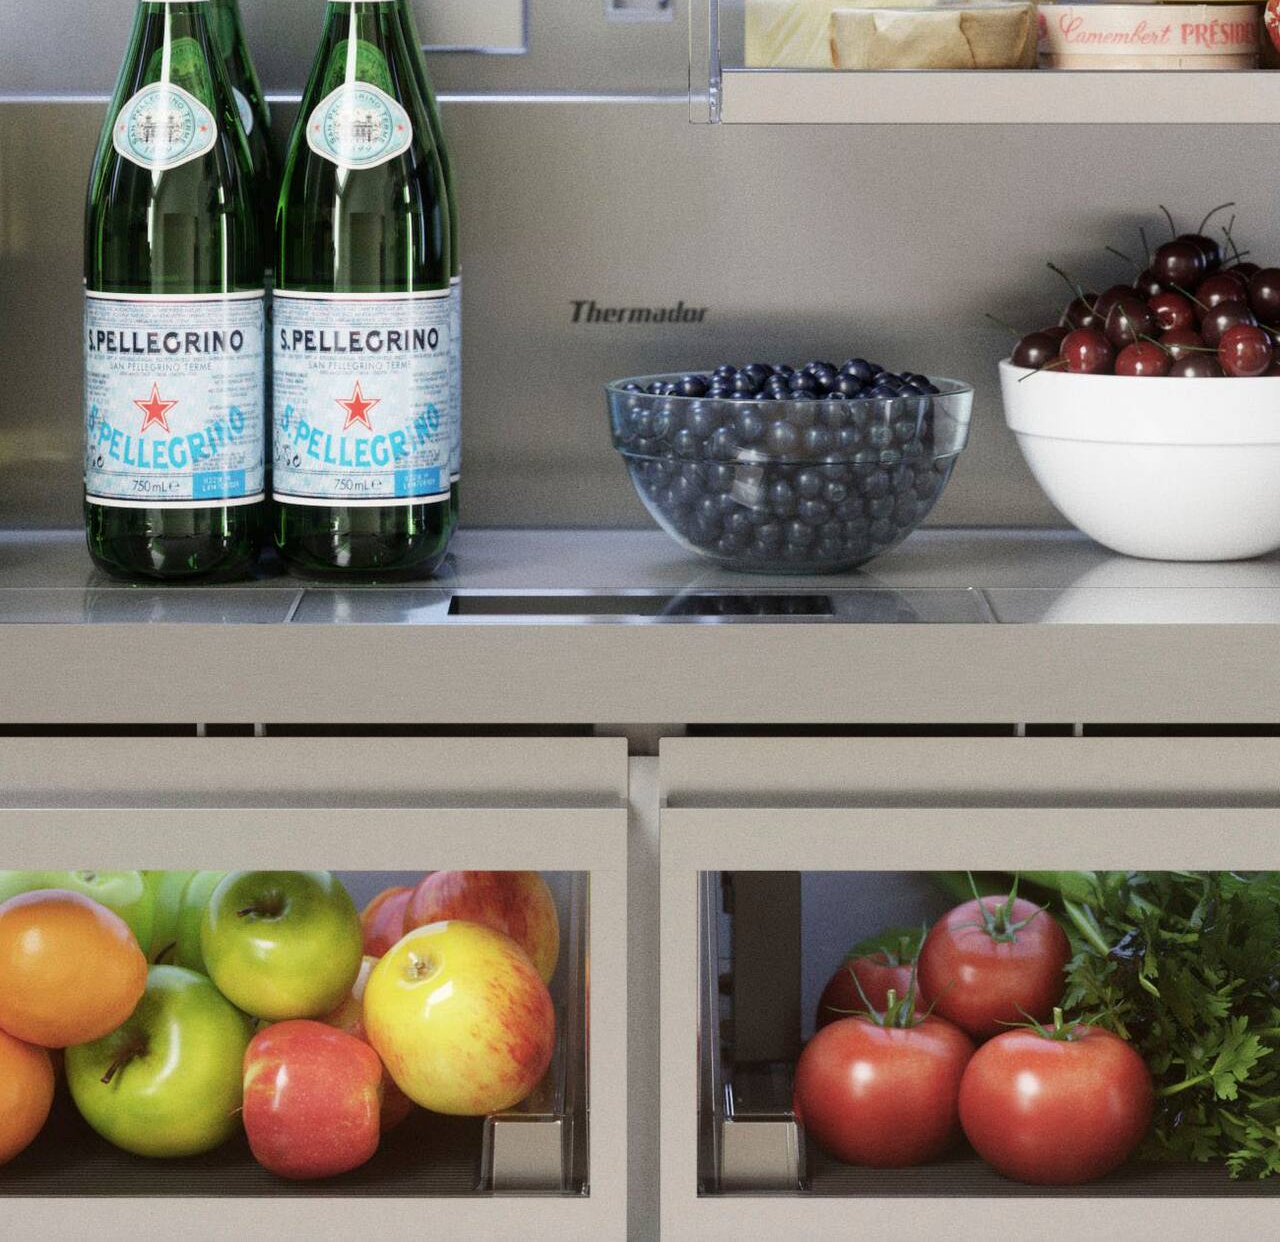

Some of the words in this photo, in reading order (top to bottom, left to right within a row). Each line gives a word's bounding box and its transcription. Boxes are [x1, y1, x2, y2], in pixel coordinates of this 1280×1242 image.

[1058, 13, 1171, 46] Camembert
[570, 299, 709, 324] Thermador
[88, 329, 244, 354] S.PELLEGRINO
[280, 327, 439, 352] S.PELLEGRINO
[110, 362, 125, 371] SAN
[127, 362, 180, 372] PELLEGRINO
[184, 362, 212, 371] TERME
[308, 360, 326, 370] SAN
[328, 361, 383, 371] PELLEGRINO
[88, 404, 245, 470] S.PELLEGRINO
[281, 402, 441, 468] S.PELLEGRINO
